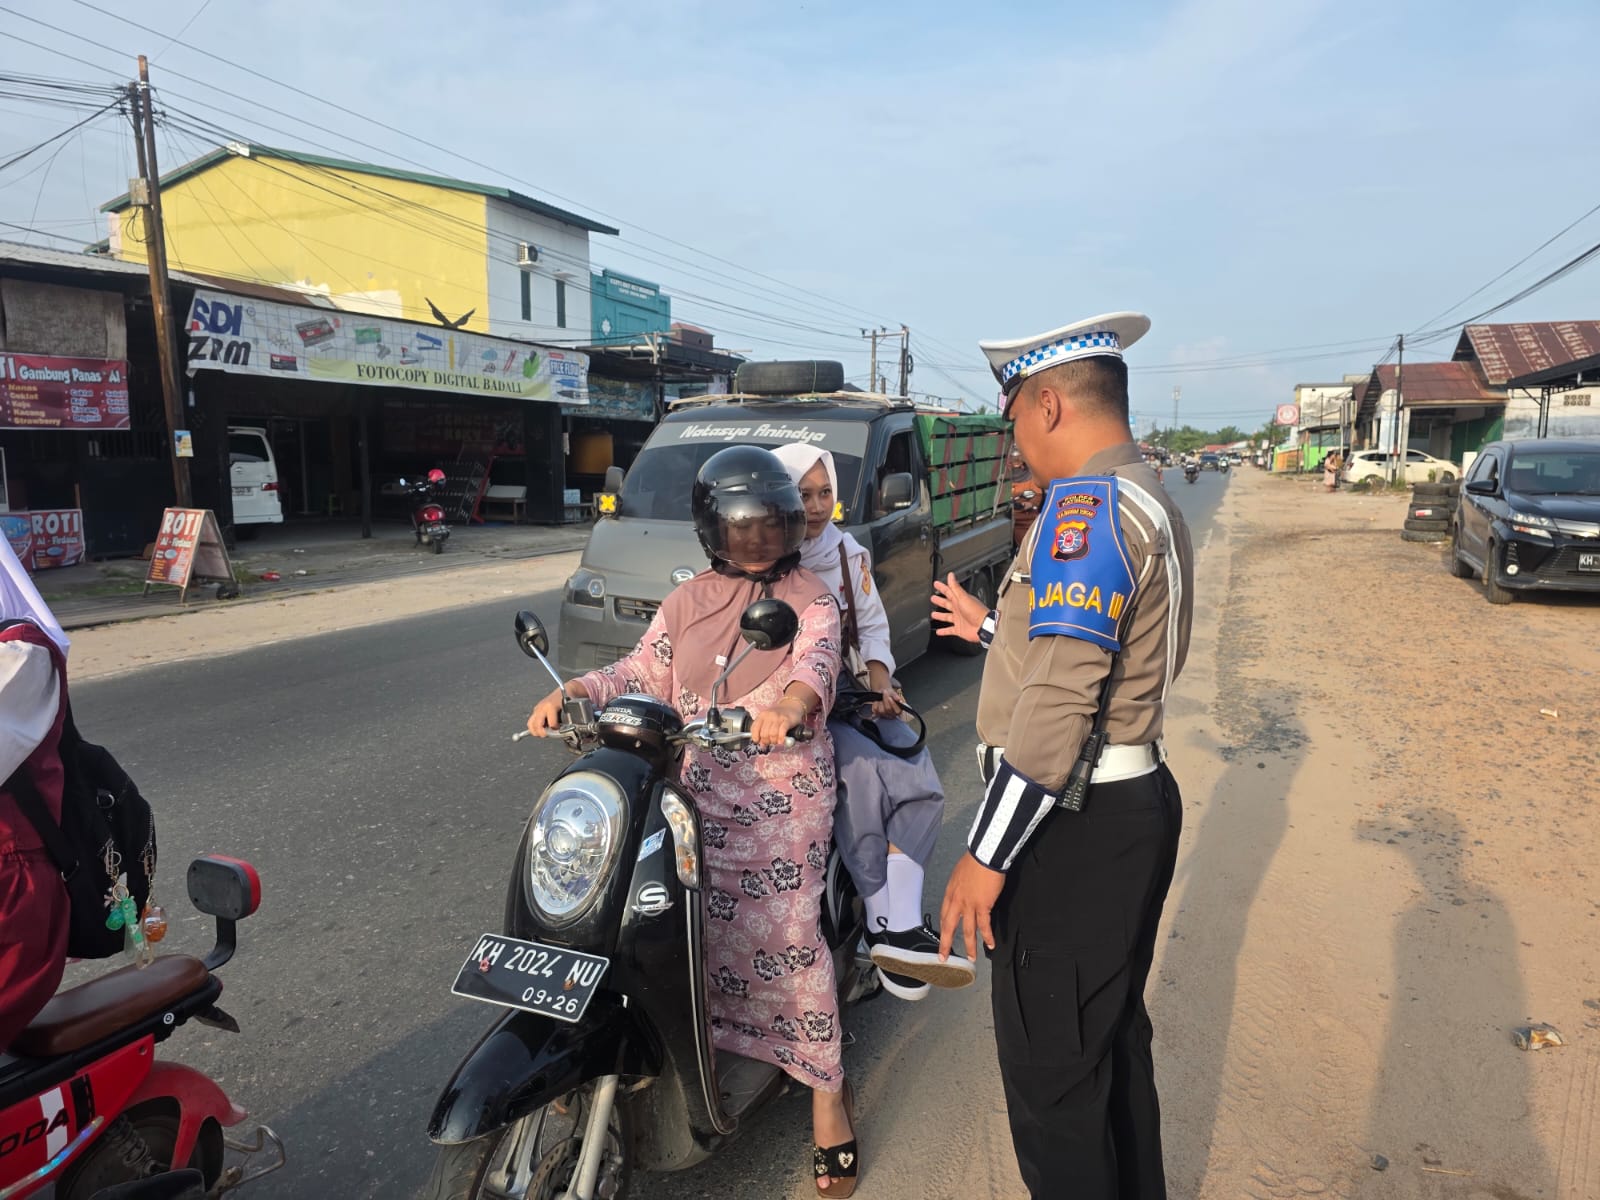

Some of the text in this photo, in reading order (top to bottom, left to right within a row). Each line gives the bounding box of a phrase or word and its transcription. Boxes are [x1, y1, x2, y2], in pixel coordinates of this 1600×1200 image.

[191, 298, 243, 336] SDI
[72, 367, 102, 382] Panas
[356, 364, 430, 384] FOTOCOPY
[433, 371, 480, 389] DIGITAL
[680, 423, 826, 444] Natasya Anindya
[32, 512, 79, 535] ROTI
[162, 511, 201, 536] ROTI
[1580, 554, 1593, 566] KH
[1038, 581, 1103, 615] JAGA
[471, 939, 602, 987] KH 2024 NU
